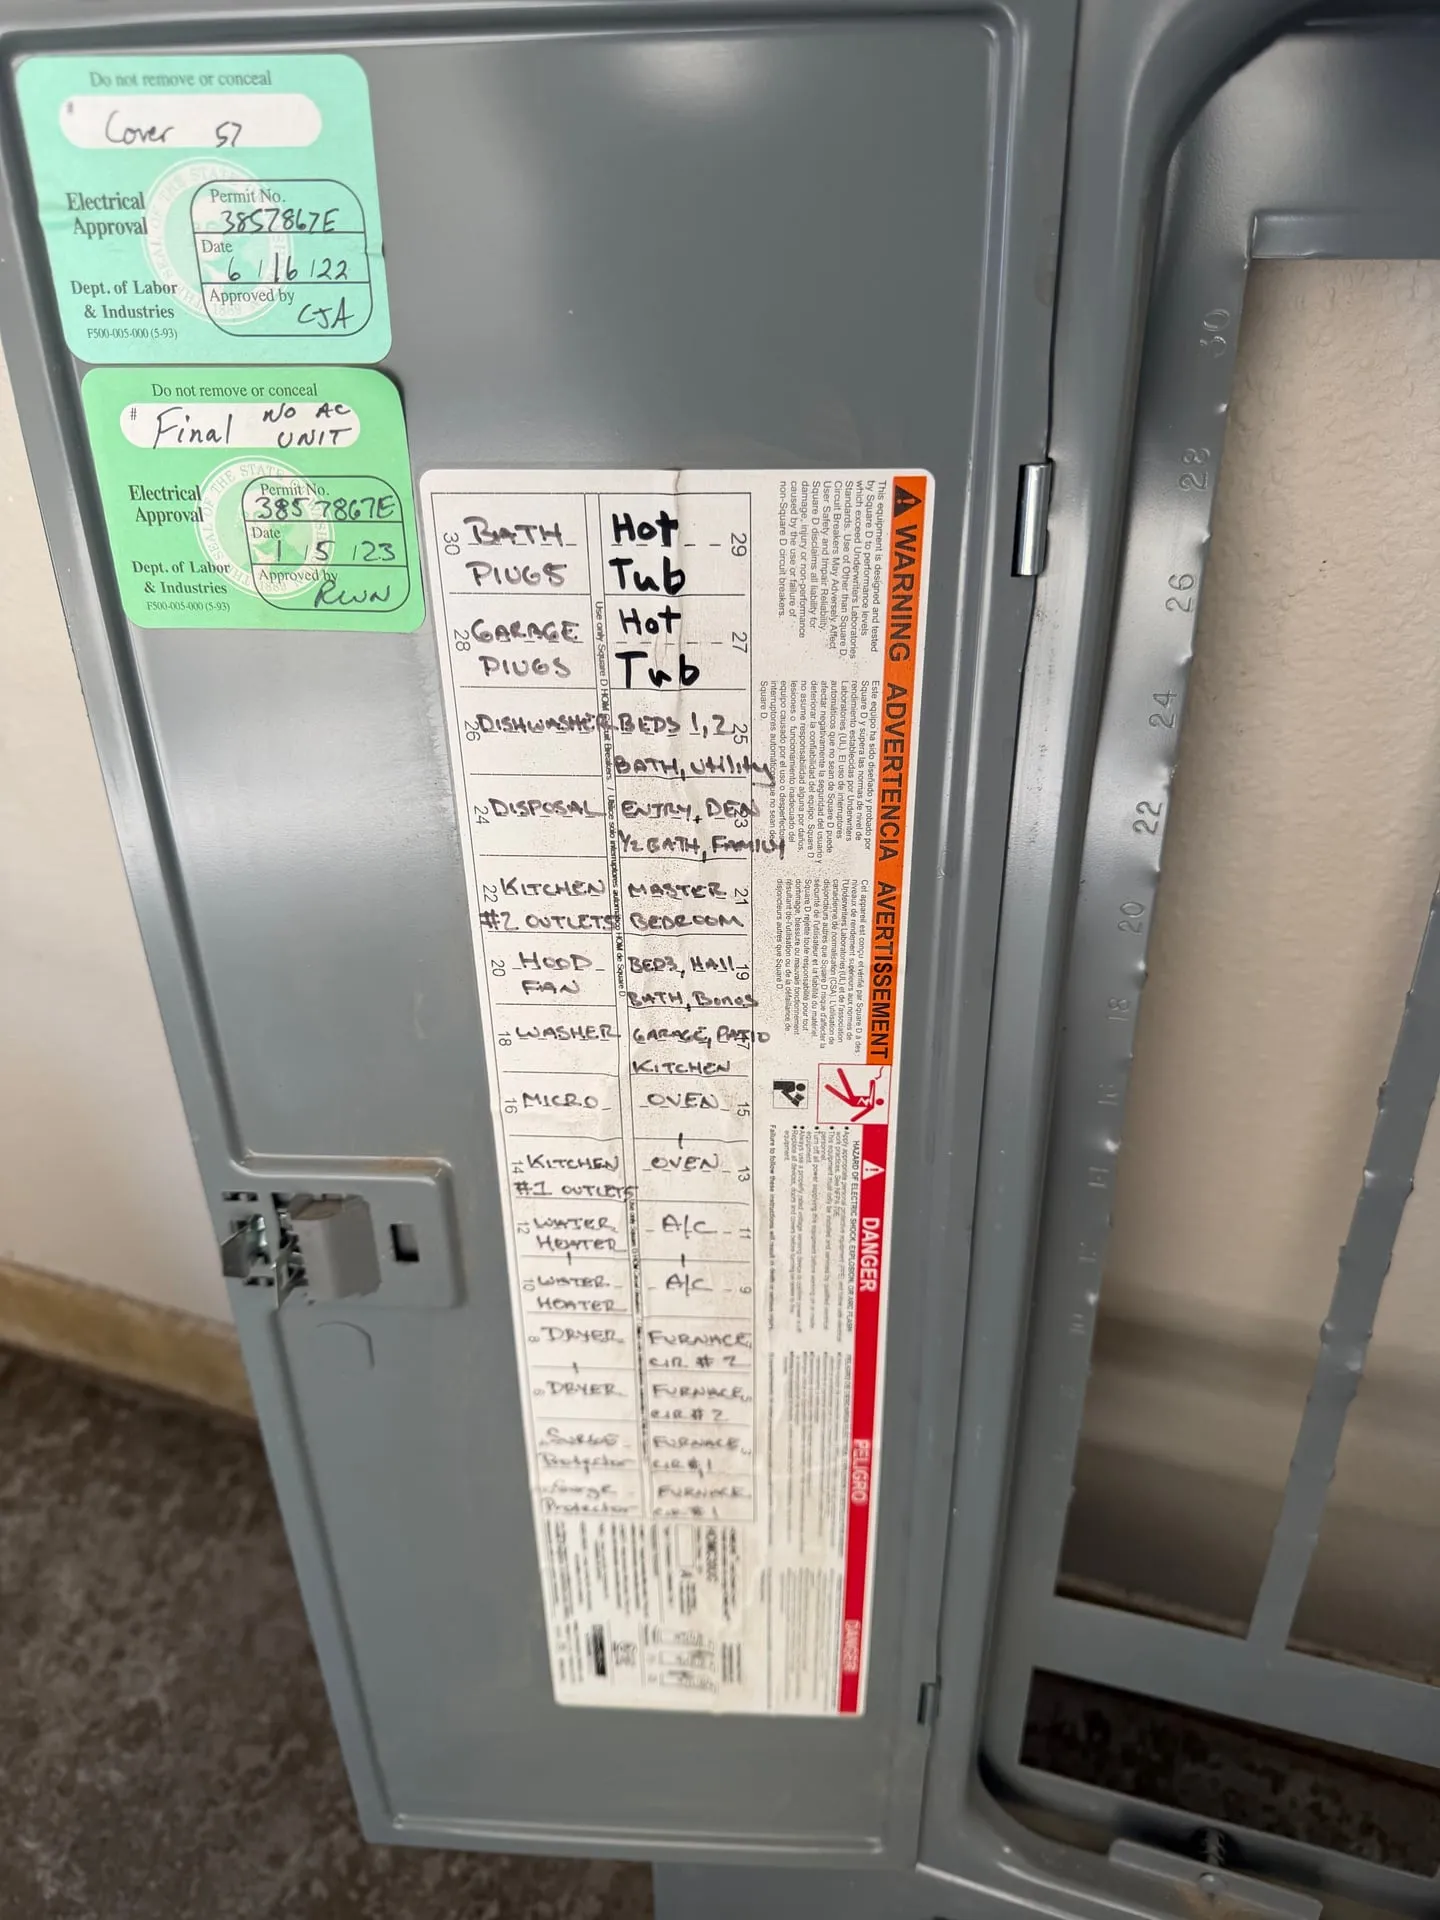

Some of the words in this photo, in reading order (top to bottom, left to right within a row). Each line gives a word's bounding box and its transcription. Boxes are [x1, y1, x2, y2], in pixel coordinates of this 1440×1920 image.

[90, 71, 112, 87] Do
[113, 73, 139, 87] not
[142, 74, 195, 87] remove
[199, 73, 214, 86] or
[218, 70, 272, 86] conceal
[105, 110, 175, 144] Cover
[66, 192, 146, 211] Electrical
[210, 188, 258, 203] Permit
[260, 190, 285, 203] No.
[73, 218, 148, 239] Approval
[201, 239, 233, 253] Date
[71, 280, 111, 297] Dept.
[114, 280, 128, 295] of
[134, 281, 177, 295] Labor
[209, 289, 275, 304] Approved
[278, 289, 295, 304] by
[84, 305, 99, 319] &
[103, 304, 174, 320] Industries
[87, 327, 148, 339] F500-005-000
[150, 327, 178, 340] (5-93)
[152, 384, 170, 396] Do
[173, 385, 195, 396] not
[198, 386, 247, 397] remove
[251, 385, 265, 396] or
[268, 384, 317, 396] conceal
[153, 407, 232, 449] Final
[278, 428, 352, 448] UNIT
[1179, 448, 1211, 491] 28
[128, 485, 202, 502] Electrical
[260, 484, 303, 497] Permit
[306, 484, 329, 496] No.
[855, 480, 863, 507] which
[865, 480, 874, 492] by
[877, 480, 886, 500] This
[135, 507, 205, 526] Approval
[865, 495, 874, 528] Square
[252, 527, 280, 539] Date
[464, 516, 563, 546] BATH
[612, 510, 679, 546] Hot
[854, 510, 862, 543] exceed
[874, 502, 885, 552] equipment
[444, 531, 461, 556] 30
[731, 532, 747, 557] 29
[865, 541, 872, 550] to
[875, 554, 882, 562] is
[132, 561, 168, 577] Dept.
[171, 561, 184, 574] of
[190, 562, 230, 574] Labor
[259, 569, 319, 583] Approved
[322, 570, 337, 583] by
[609, 556, 686, 594] Tub
[852, 547, 861, 603] Underwriters
[144, 582, 157, 594] &
[160, 581, 227, 595] Industries
[861, 553, 871, 608] performance
[871, 564, 882, 604] designed
[889, 524, 917, 662] WARNING
[1166, 573, 1195, 613] 26
[206, 602, 230, 612] (5-93)
[872, 607, 880, 623] and
[618, 605, 681, 636] Hot
[861, 611, 869, 636] levels
[471, 619, 580, 643] GARAGE
[850, 606, 859, 659] Laboratories
[871, 626, 880, 652] tested
[454, 630, 471, 652] 28
[732, 631, 747, 653] 27
[615, 651, 699, 689] Tub
[1149, 690, 1178, 729] 24
[464, 722, 480, 742] 26
[619, 714, 681, 733] BEDS
[733, 722, 748, 745] 25
[879, 682, 908, 861] ADVERTENCIA
[474, 806, 489, 825] 24
[489, 798, 606, 817] DISPOSAL
[1132, 800, 1162, 836] 22
[483, 884, 497, 903] 22
[499, 877, 606, 896] KITCHEN
[628, 882, 727, 899] MASTER
[735, 888, 748, 905] 21
[526, 913, 616, 930] OUTLETS
[630, 912, 744, 930] BEDROOM
[1118, 900, 1146, 936] 20
[491, 960, 505, 977] 20
[519, 952, 592, 971] HOOD
[870, 881, 897, 1059] AVERTISSEMENT
[736, 964, 749, 981] 19
[522, 980, 581, 994] FAN
[497, 1032, 511, 1047] 18
[516, 1024, 621, 1040] WASHER
[633, 1061, 731, 1074] KITCHEN
[505, 1097, 517, 1114] 16
[523, 1092, 599, 1109] MICRO
[647, 1092, 719, 1109] OVEN
[737, 1102, 750, 1117] 15
[526, 1154, 619, 1170] KITCHEN
[651, 1154, 719, 1170] OVEN
[738, 1167, 750, 1182] 13
[533, 1217, 618, 1232] WATER
[661, 1214, 718, 1239] A/C
[859, 1217, 880, 1292] DANGER
[666, 1273, 712, 1297] A/C
[851, 1439, 870, 1505] PELIGRO
